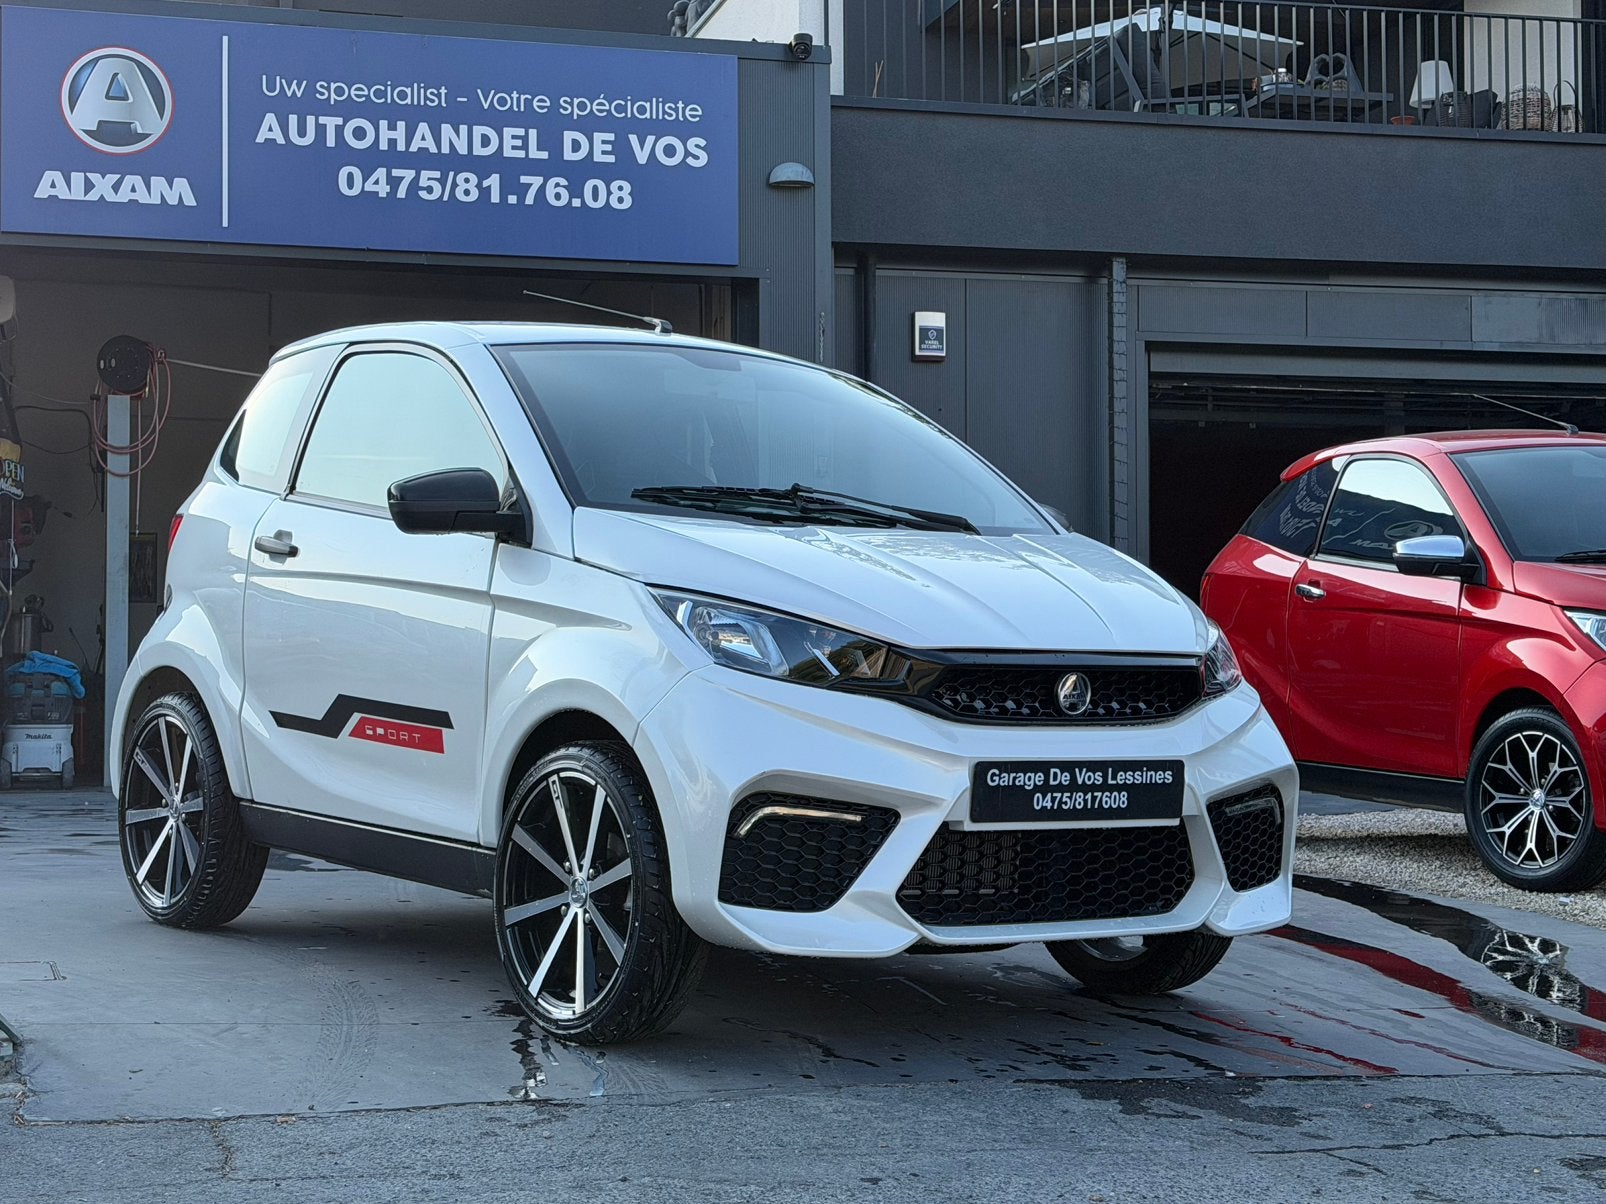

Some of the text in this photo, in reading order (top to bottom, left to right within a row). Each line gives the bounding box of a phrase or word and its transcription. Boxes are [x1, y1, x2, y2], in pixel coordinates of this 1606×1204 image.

[261, 74, 308, 98] Uw
[315, 81, 448, 108] specialist
[476, 88, 551, 113] Votre
[558, 93, 703, 122] spécialiste
[254, 112, 709, 168] AUTOHANDEL DE VOS
[33, 170, 198, 206] AIXAM
[337, 165, 633, 210] 0475/81.76.08
[365, 725, 421, 744] SPORT
[986, 767, 1173, 790] Garage De Vos Lessines
[1033, 791, 1128, 810] 0475/817608
